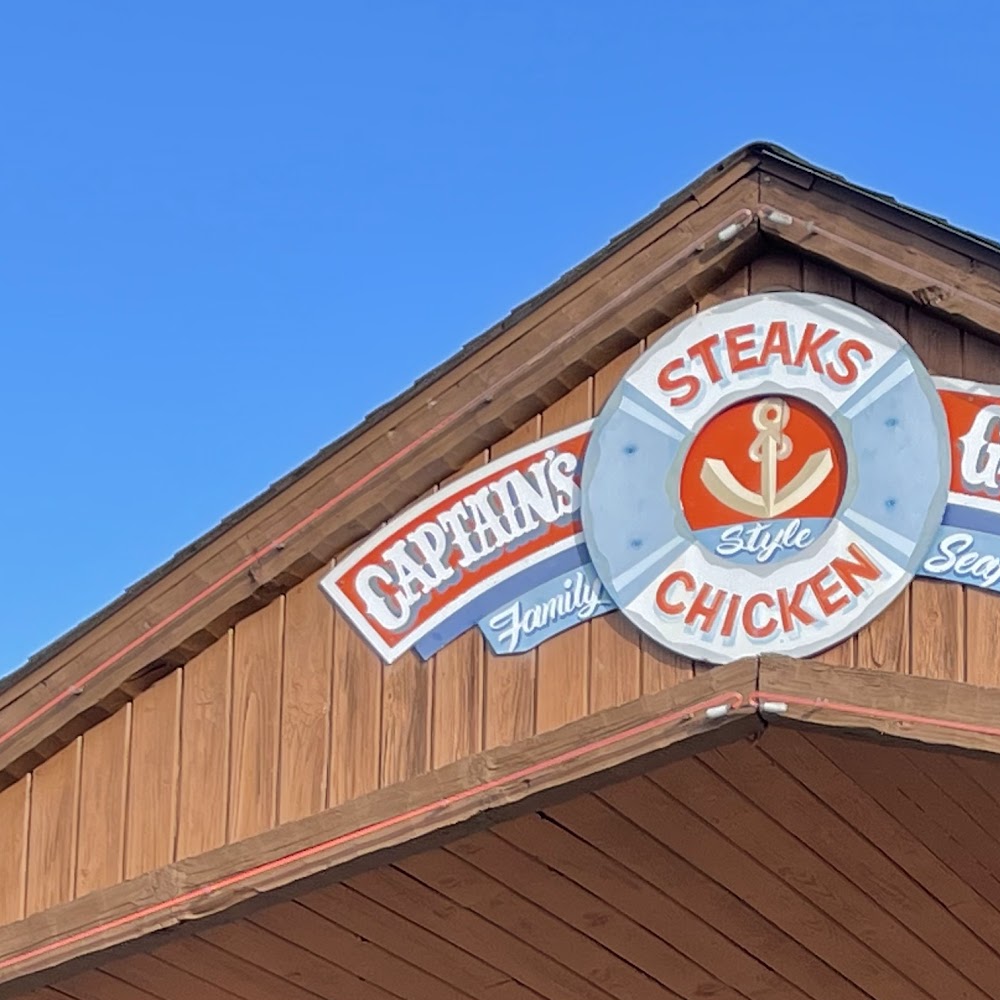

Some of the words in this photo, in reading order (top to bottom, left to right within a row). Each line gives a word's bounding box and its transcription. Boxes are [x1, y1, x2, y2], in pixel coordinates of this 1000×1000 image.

[657, 320, 873, 407] STEAKS
[354, 450, 581, 631] CAPTAIN'S
[489, 571, 612, 653] Family
[716, 521, 814, 563] Style
[655, 542, 882, 638] CHICKEN
